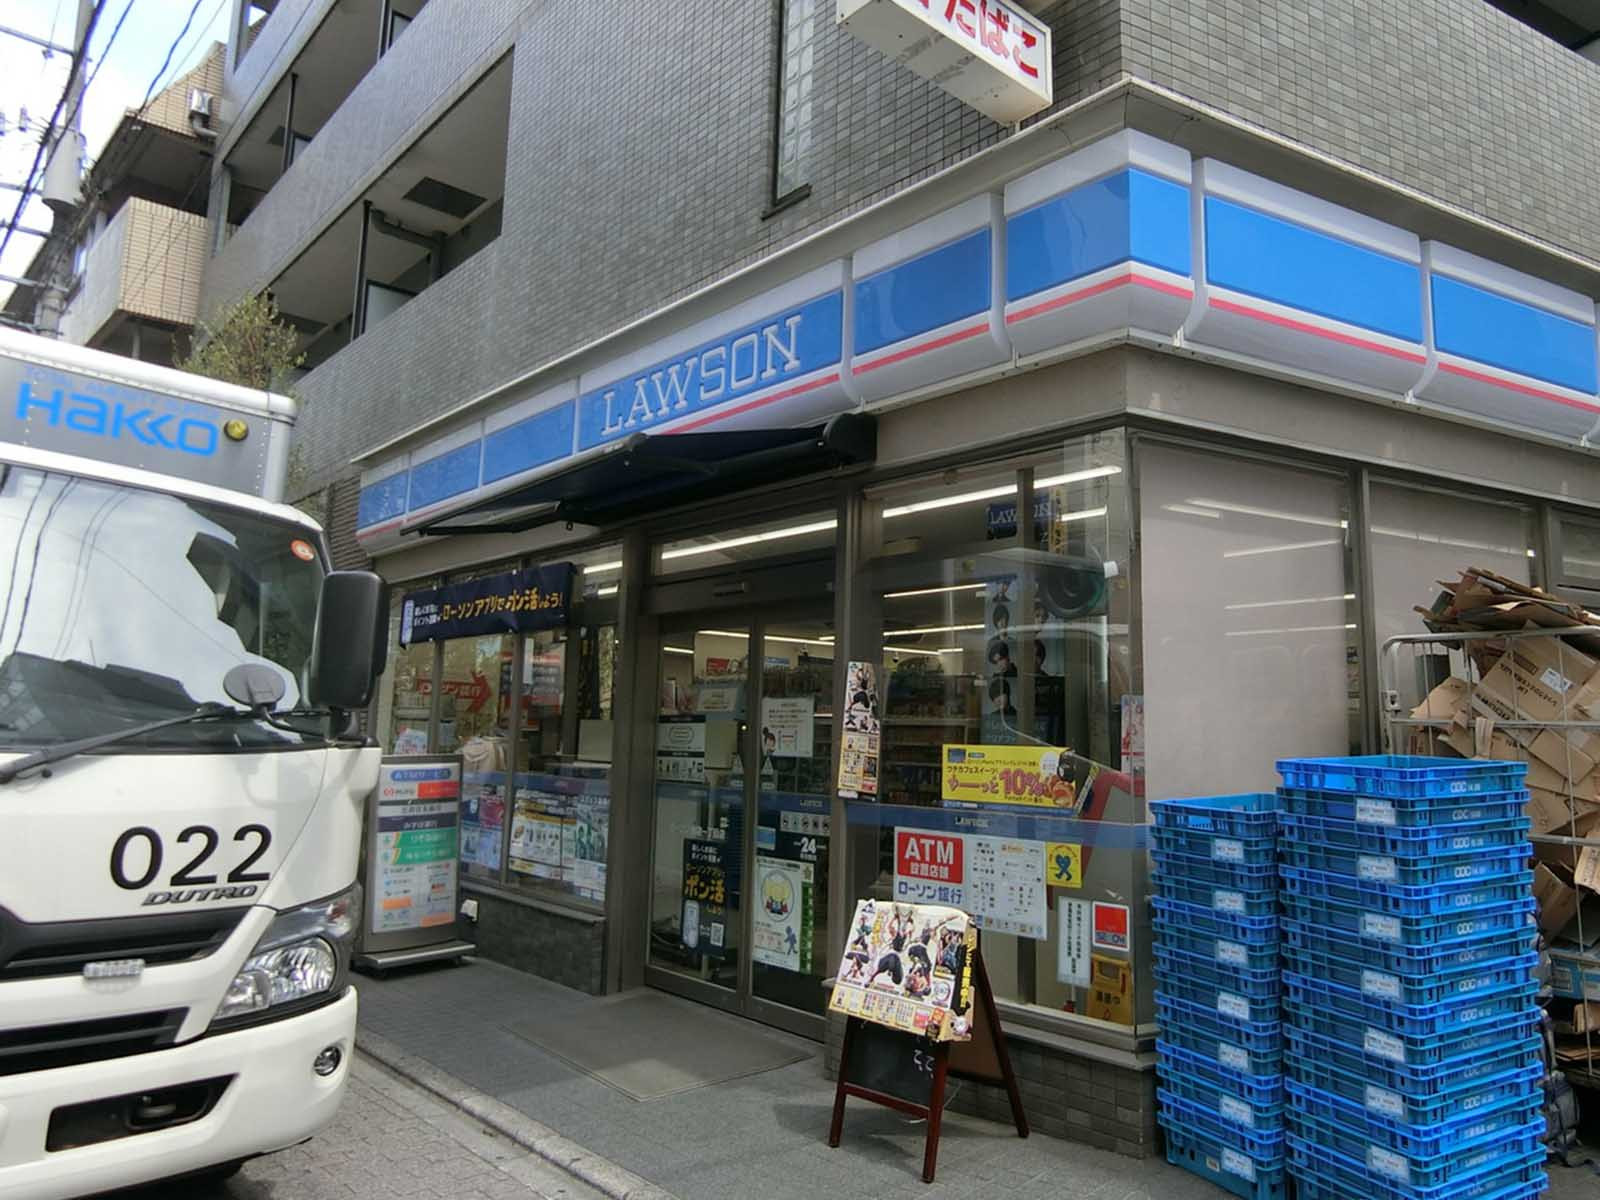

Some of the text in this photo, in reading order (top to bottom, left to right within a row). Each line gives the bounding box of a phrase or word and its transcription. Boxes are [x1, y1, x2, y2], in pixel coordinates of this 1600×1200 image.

[601, 315, 802, 436] LAWSON
[110, 823, 272, 890] 022
[800, 836, 817, 854] 24
[904, 837, 954, 865] ATM
[141, 885, 258, 906] DUTRO
[684, 874, 726, 904] ポン活
[898, 881, 963, 905] ローソン銀行
